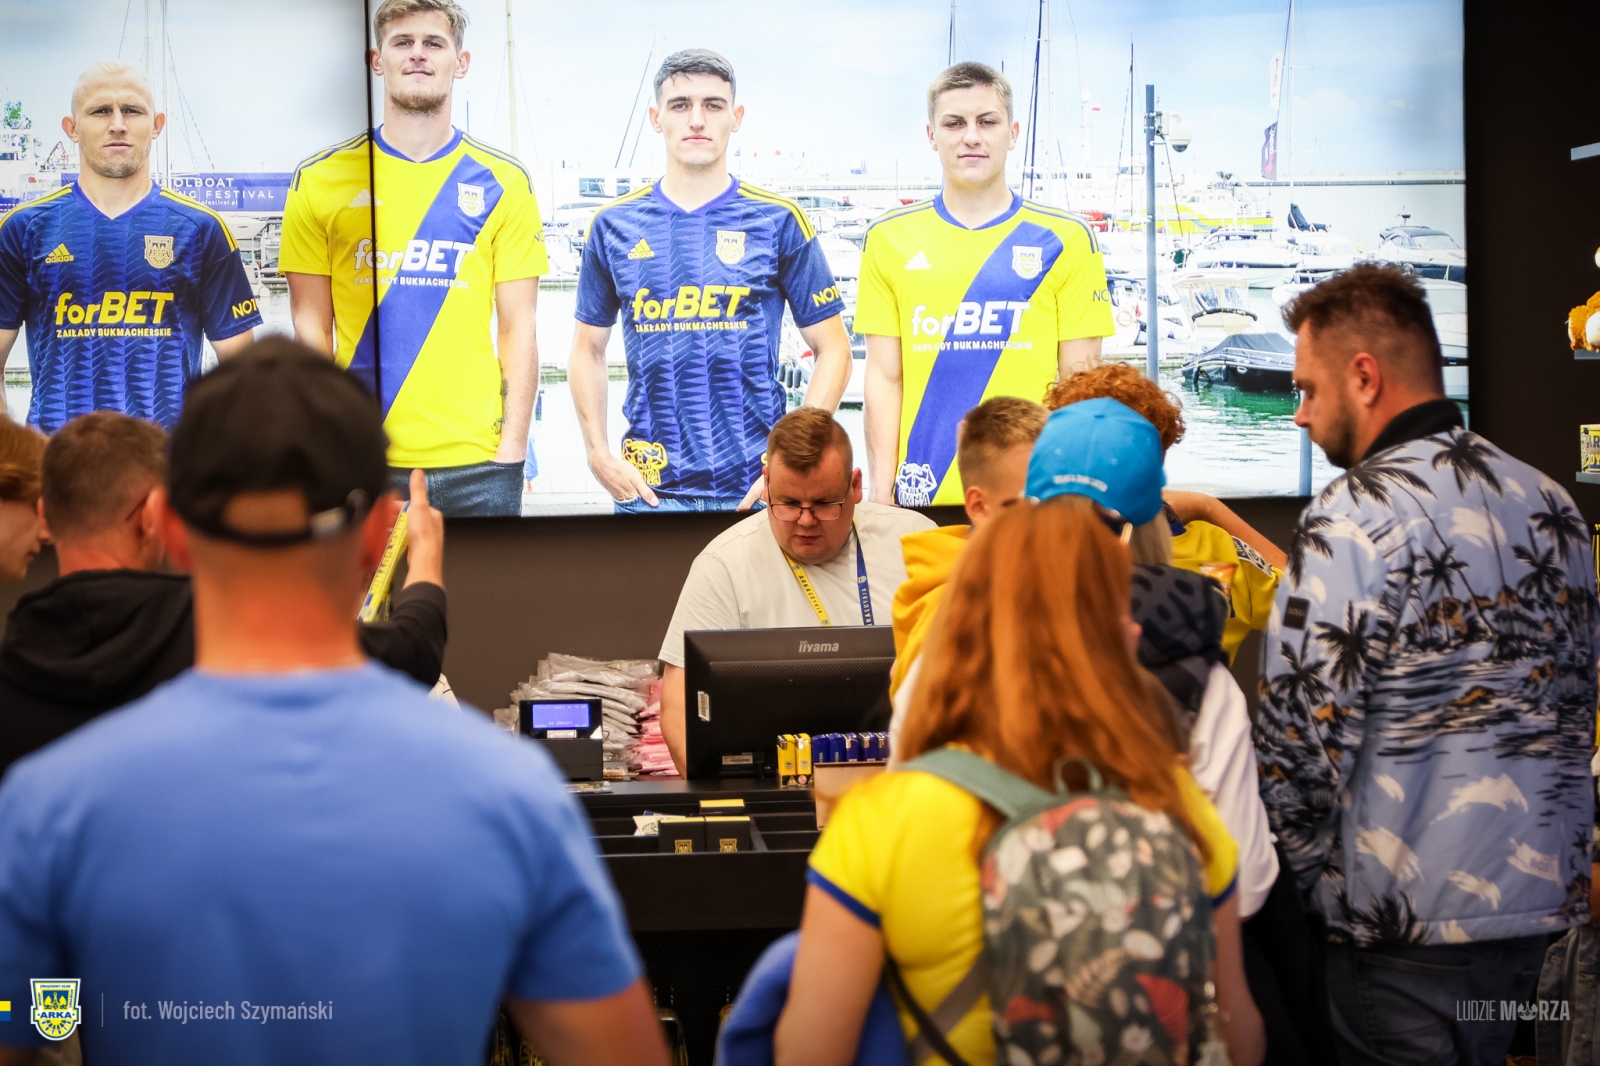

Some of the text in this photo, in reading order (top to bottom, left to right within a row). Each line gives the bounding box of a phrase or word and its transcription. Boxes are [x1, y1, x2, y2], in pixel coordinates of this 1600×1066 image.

[205, 190, 275, 199] FESTIVAL
[45, 254, 75, 264] adidas
[354, 238, 477, 274] forBET
[400, 276, 470, 290] BUKMACHERSKIE
[54, 290, 175, 325] forBET
[631, 284, 751, 321] forBET
[911, 300, 1032, 337] forBET
[673, 320, 749, 332] BUKMACHERSKIE
[98, 328, 172, 338] BUKMACHERSKIE
[952, 340, 1033, 351] BUKMACHERSKIE
[798, 640, 840, 653] iiyama
